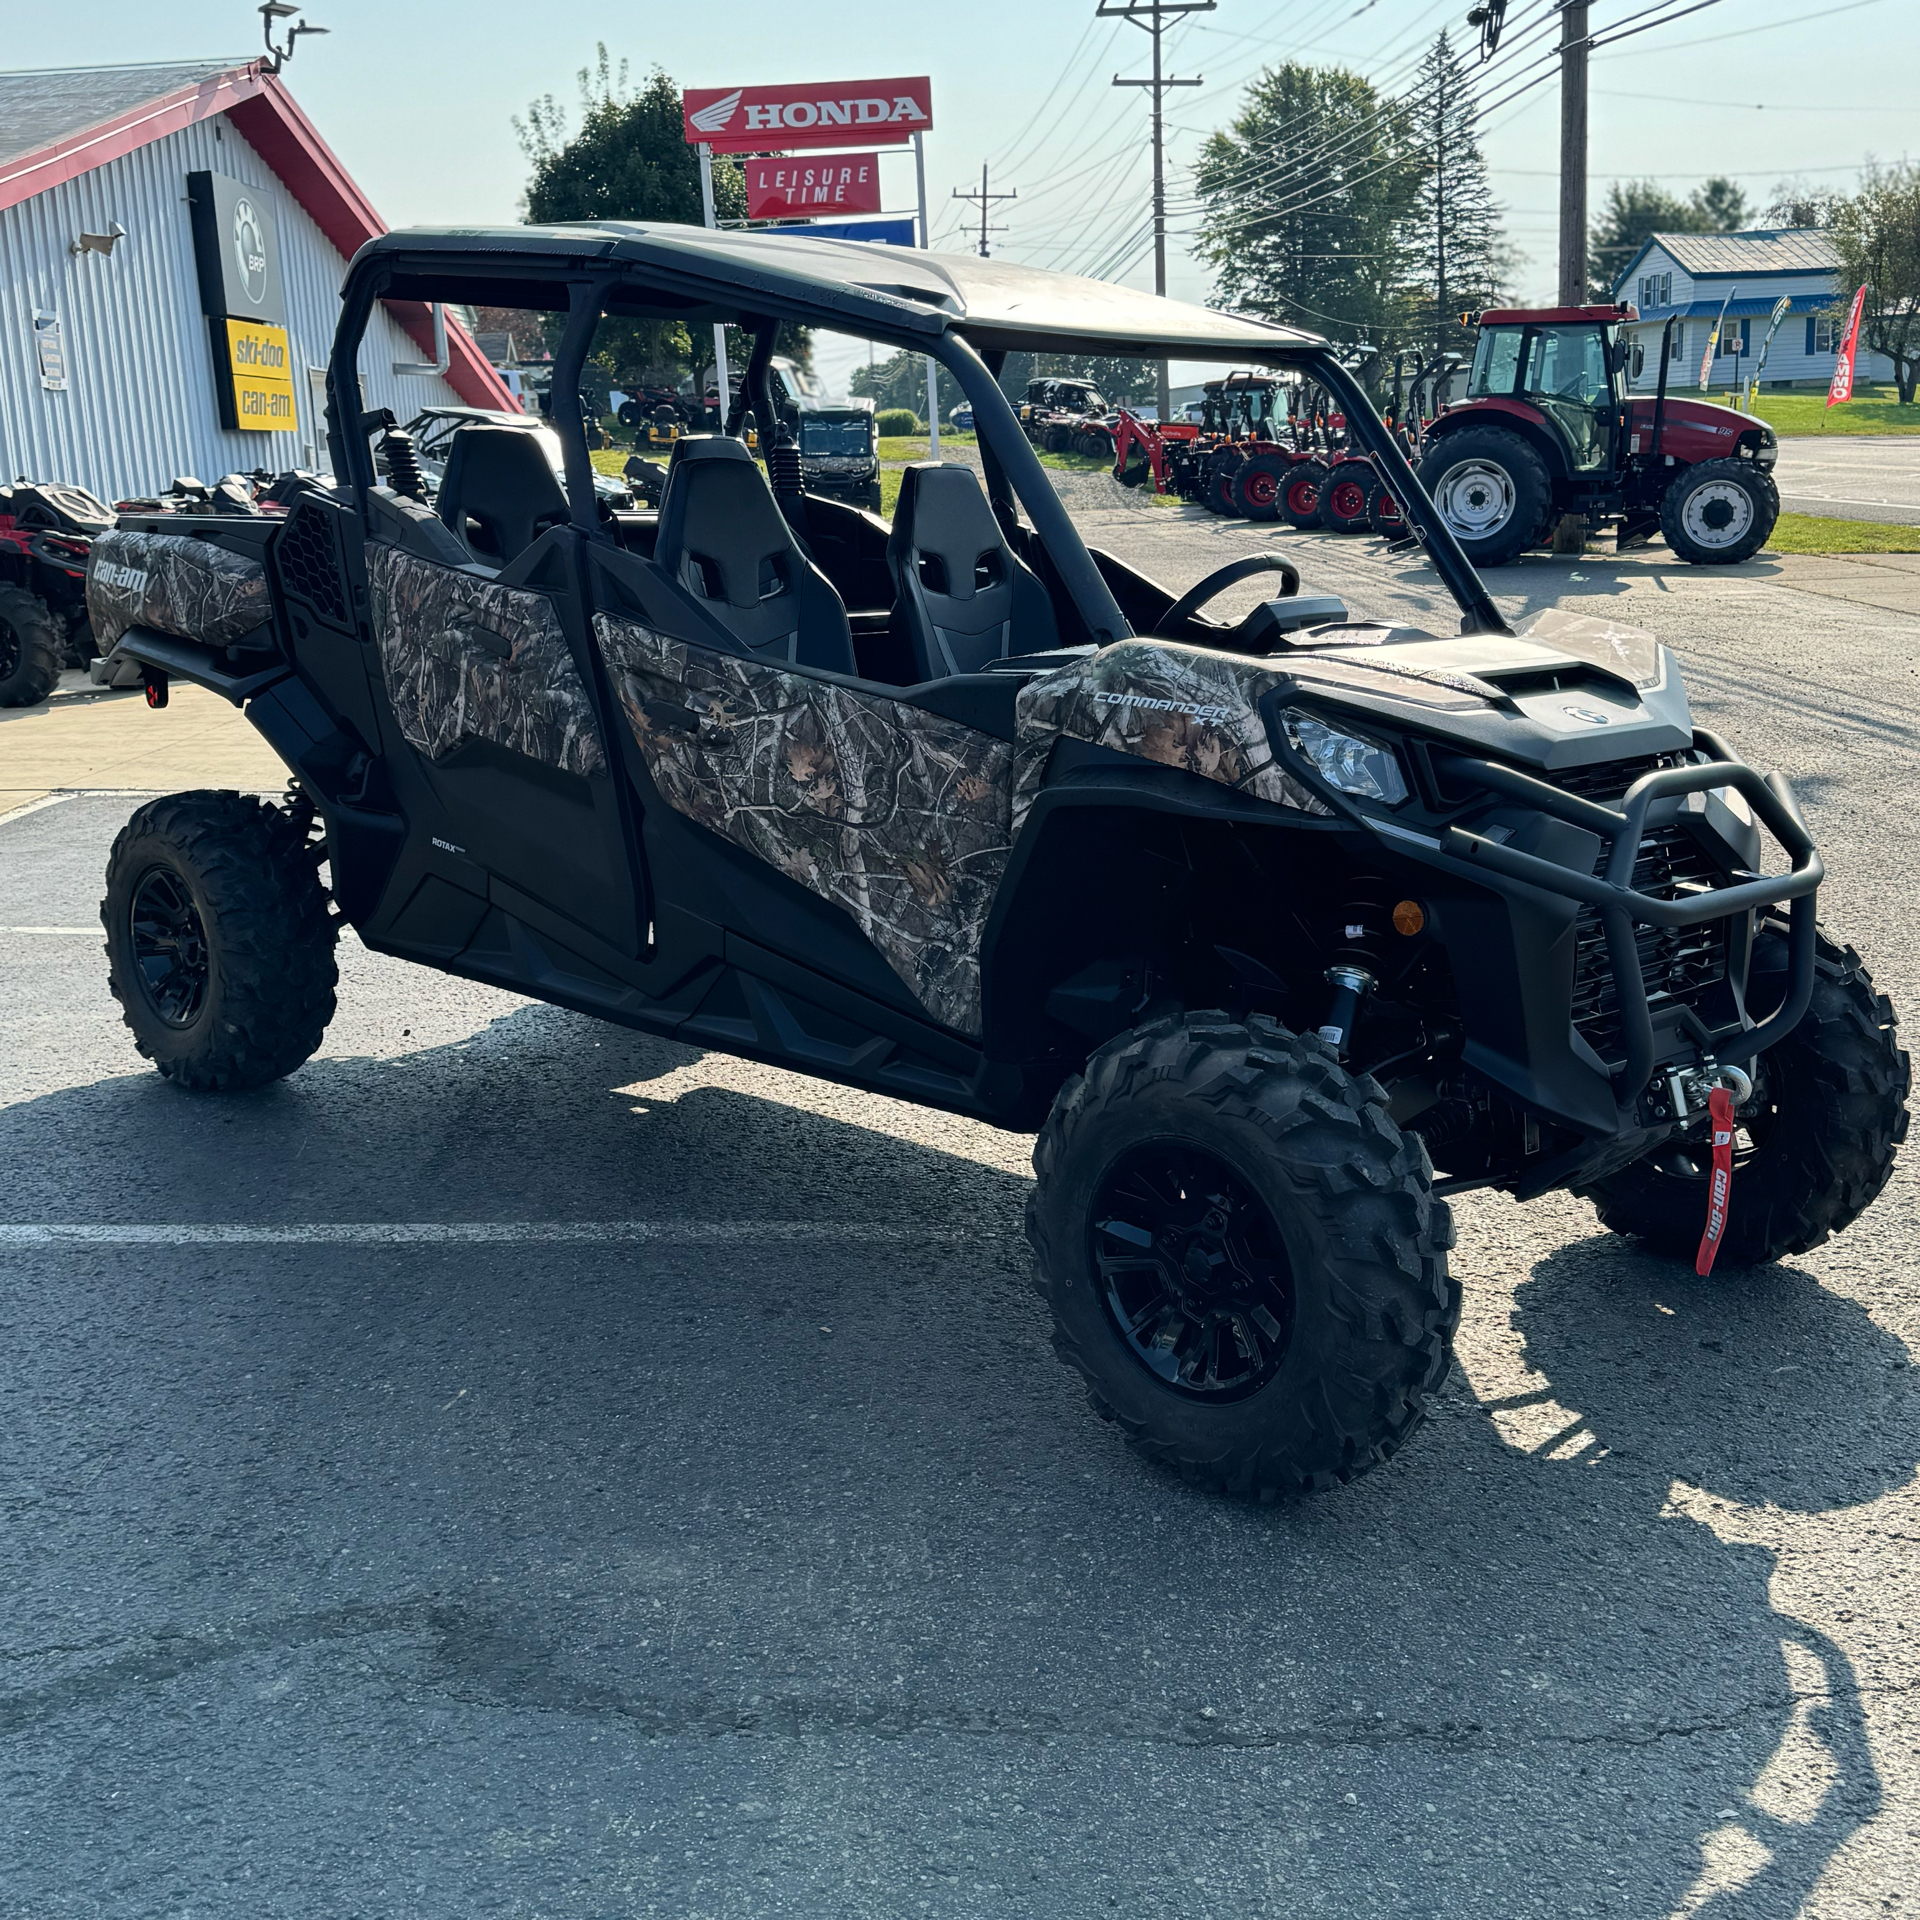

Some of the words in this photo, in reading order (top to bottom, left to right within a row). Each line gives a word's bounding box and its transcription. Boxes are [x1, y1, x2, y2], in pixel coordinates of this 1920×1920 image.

[743, 96, 928, 130] HONDA
[758, 166, 869, 189] LEISURE
[786, 185, 846, 205] TIME
[248, 254, 265, 273] BRP
[236, 335, 284, 368] ski-doo
[1832, 353, 1851, 399] AMMO
[242, 390, 291, 417] can-am
[93, 559, 149, 591] can-am
[1093, 691, 1231, 719] COMMANDER
[1190, 715, 1225, 727] XT
[431, 836, 456, 853] ROTAX
[1707, 1168, 1728, 1242] can-am
